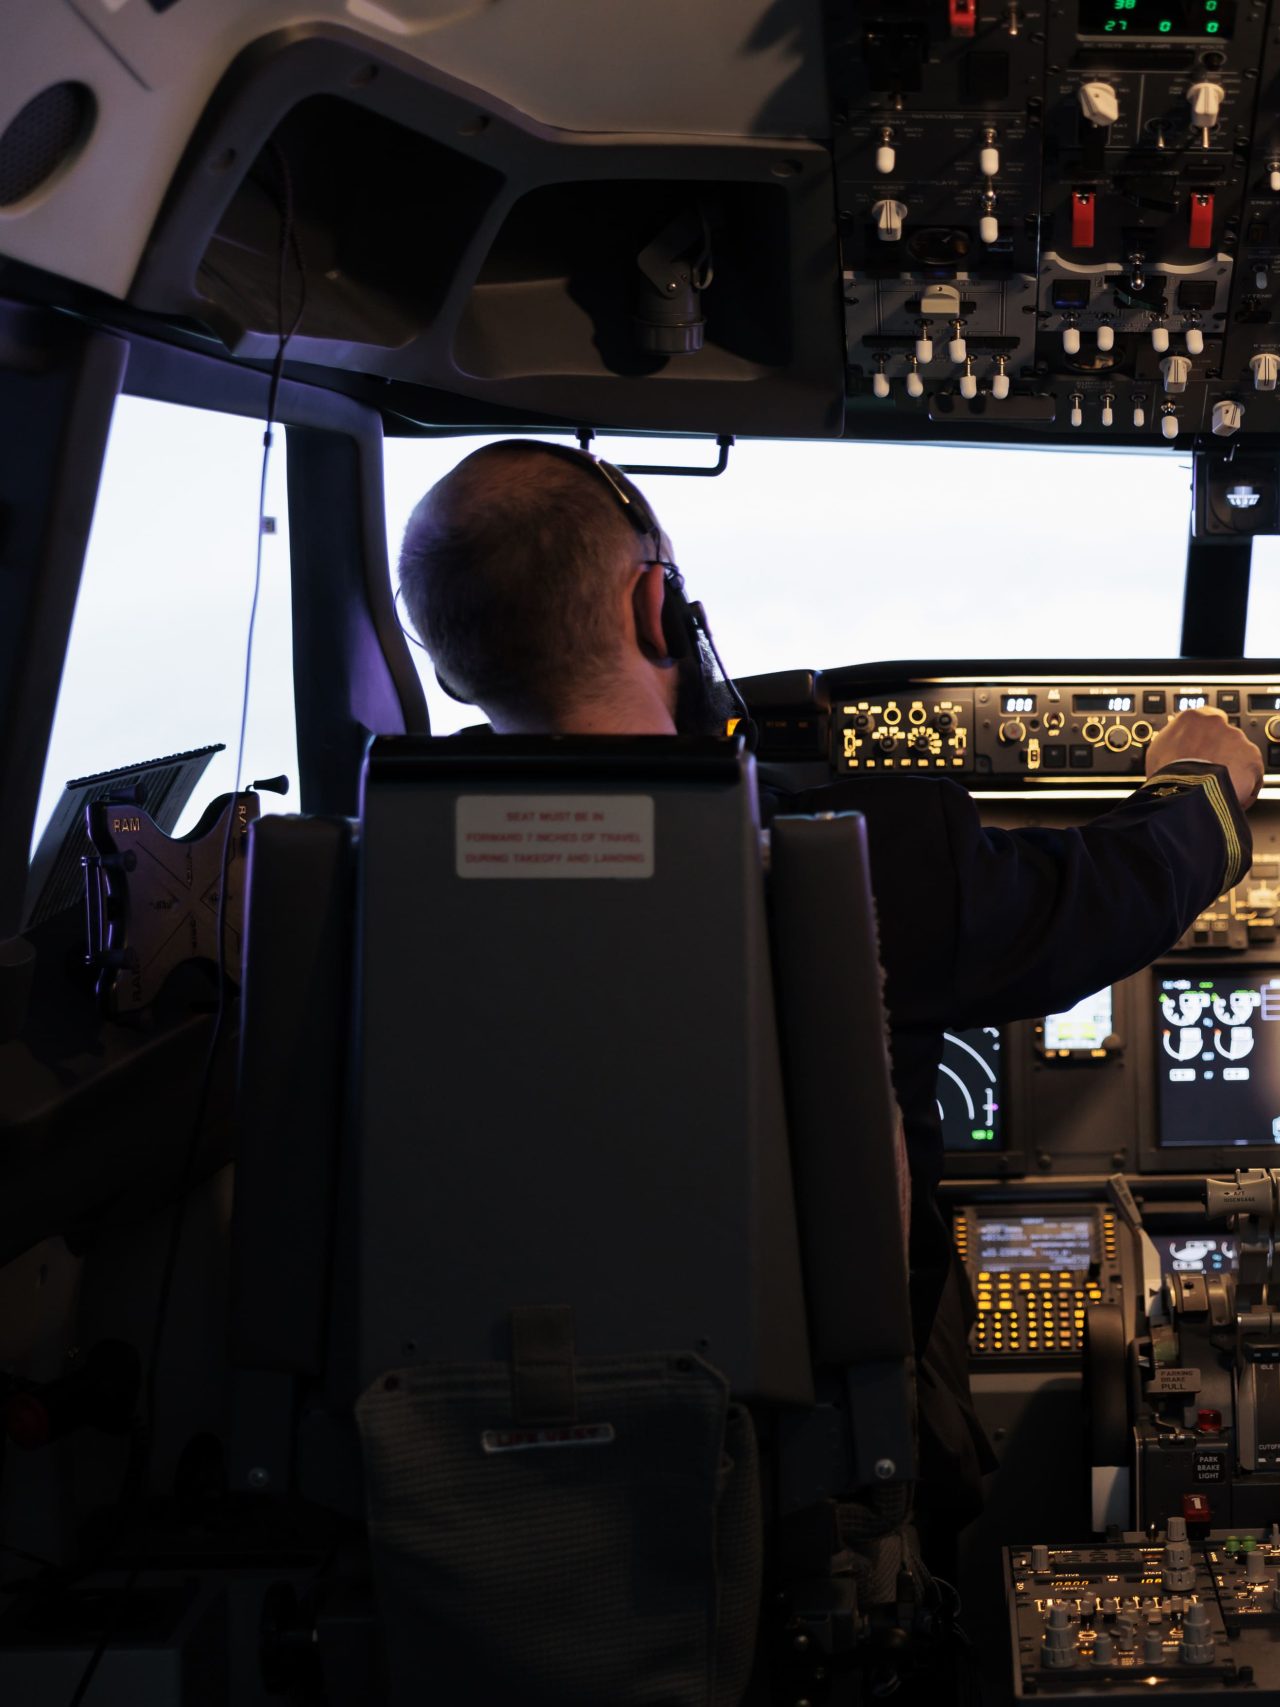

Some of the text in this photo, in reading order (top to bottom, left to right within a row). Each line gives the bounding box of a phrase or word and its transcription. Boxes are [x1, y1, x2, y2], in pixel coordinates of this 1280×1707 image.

[1103, 20, 1129, 32] 27
[1158, 19, 1173, 33] 0
[539, 811, 571, 822] MUST
[112, 818, 141, 833] RAM
[464, 832, 523, 843] FORWARD
[535, 832, 578, 843] INCHES
[600, 832, 642, 843] TRAVEL
[464, 853, 645, 864] DURING TAKEOFF AND LANDING
[1197, 1464, 1220, 1472] BRAKE
[1198, 1472, 1219, 1480] LIGHT
[1190, 1496, 1203, 1510] 1
